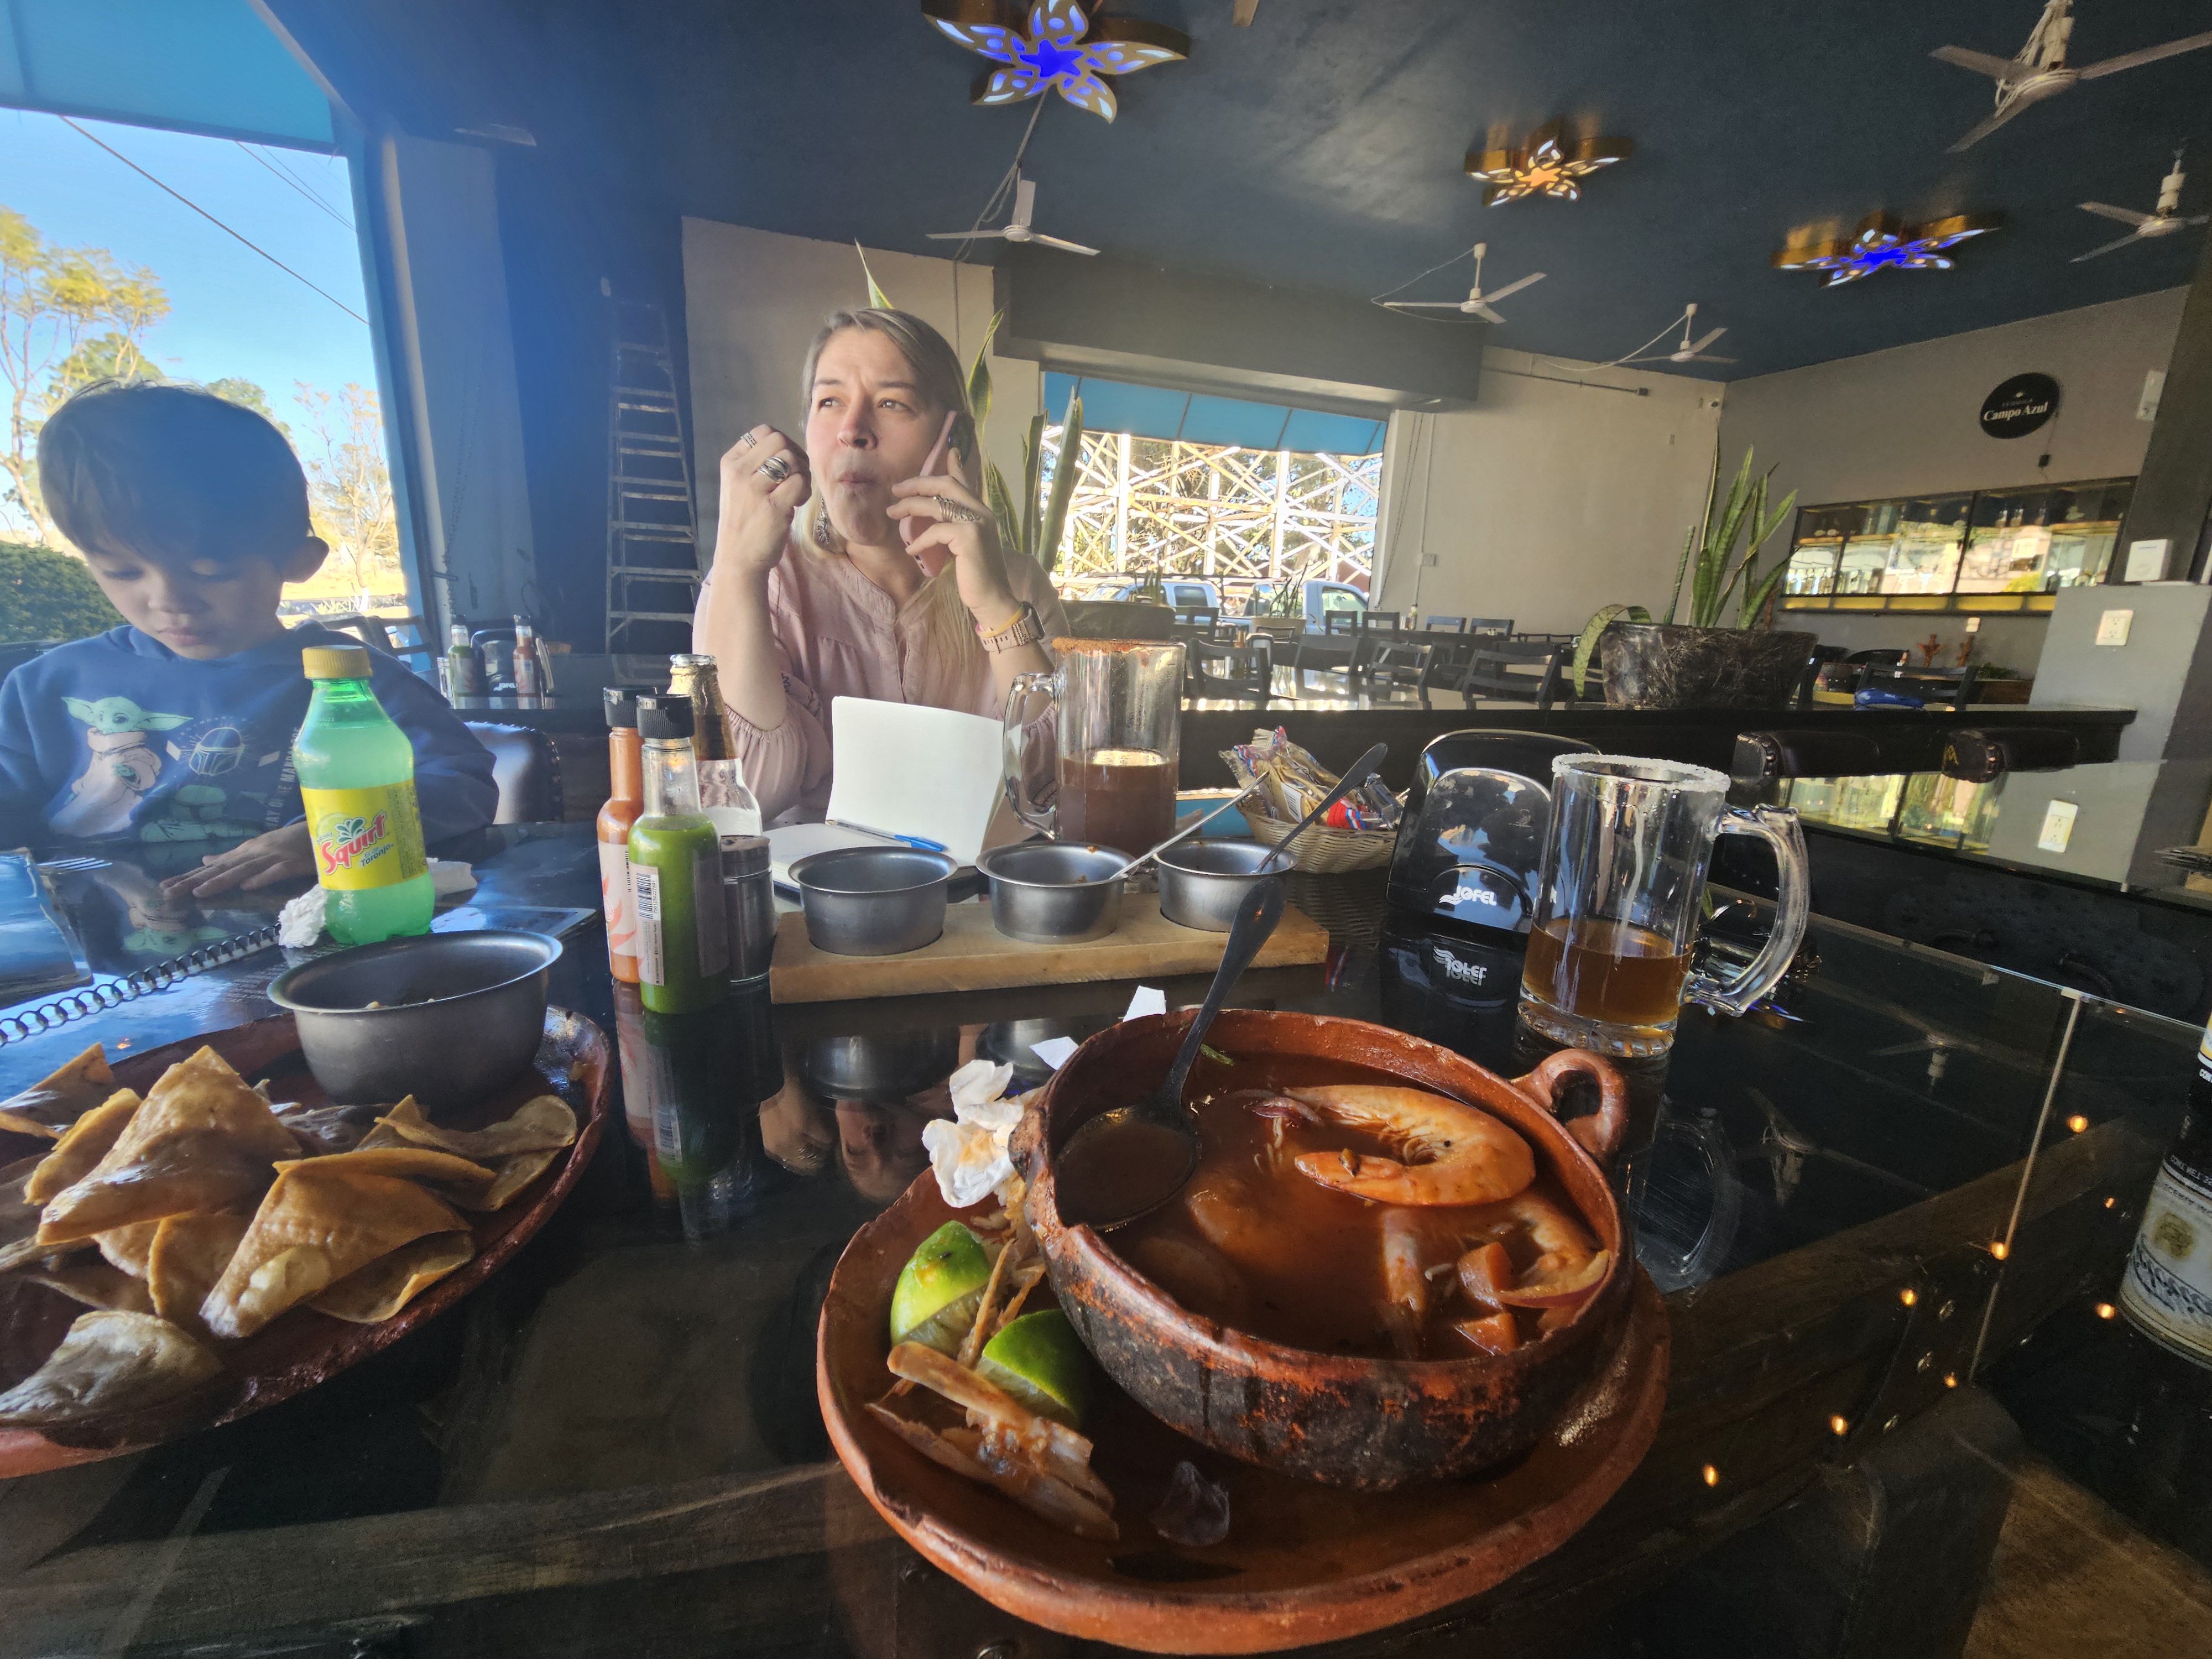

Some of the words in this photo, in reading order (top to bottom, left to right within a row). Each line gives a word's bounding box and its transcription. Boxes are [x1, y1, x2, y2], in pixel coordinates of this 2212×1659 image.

[1984, 409, 2022, 421] Campo
[2023, 401, 2048, 415] Azul
[321, 810, 387, 875] Squirt
[361, 843, 392, 867] Toronja
[1453, 885, 1497, 906] JOFEL
